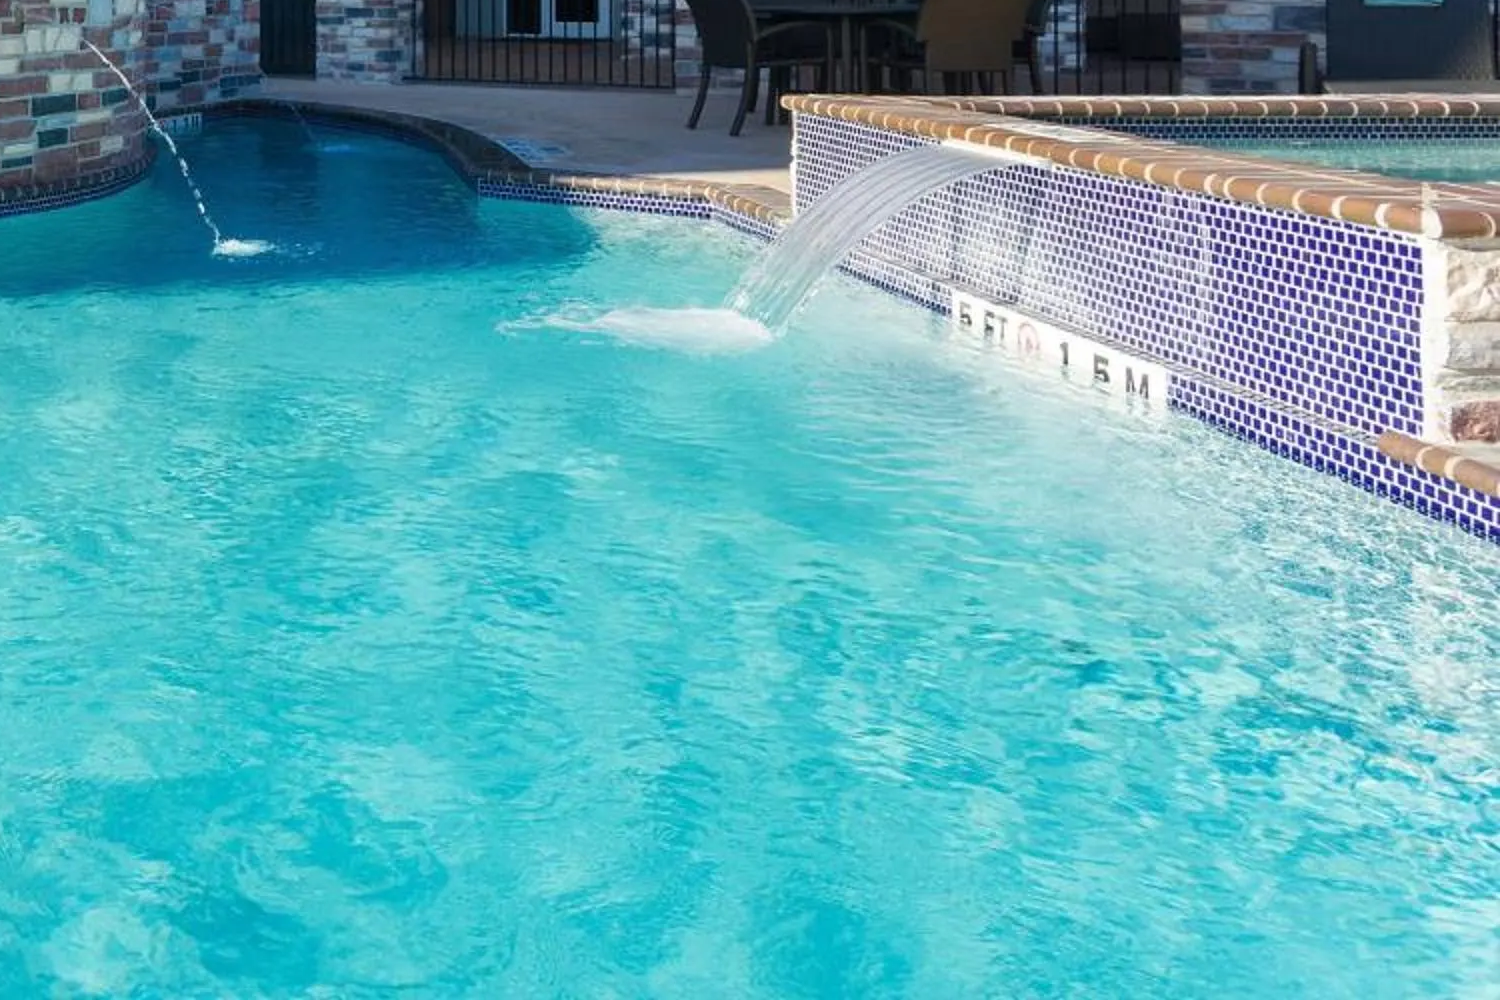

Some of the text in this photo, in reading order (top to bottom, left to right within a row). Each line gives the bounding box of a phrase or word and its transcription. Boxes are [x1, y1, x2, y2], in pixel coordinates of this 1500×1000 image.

[959, 301, 973, 327] 5
[984, 310, 1008, 340] FT
[1125, 366, 1150, 400] M
